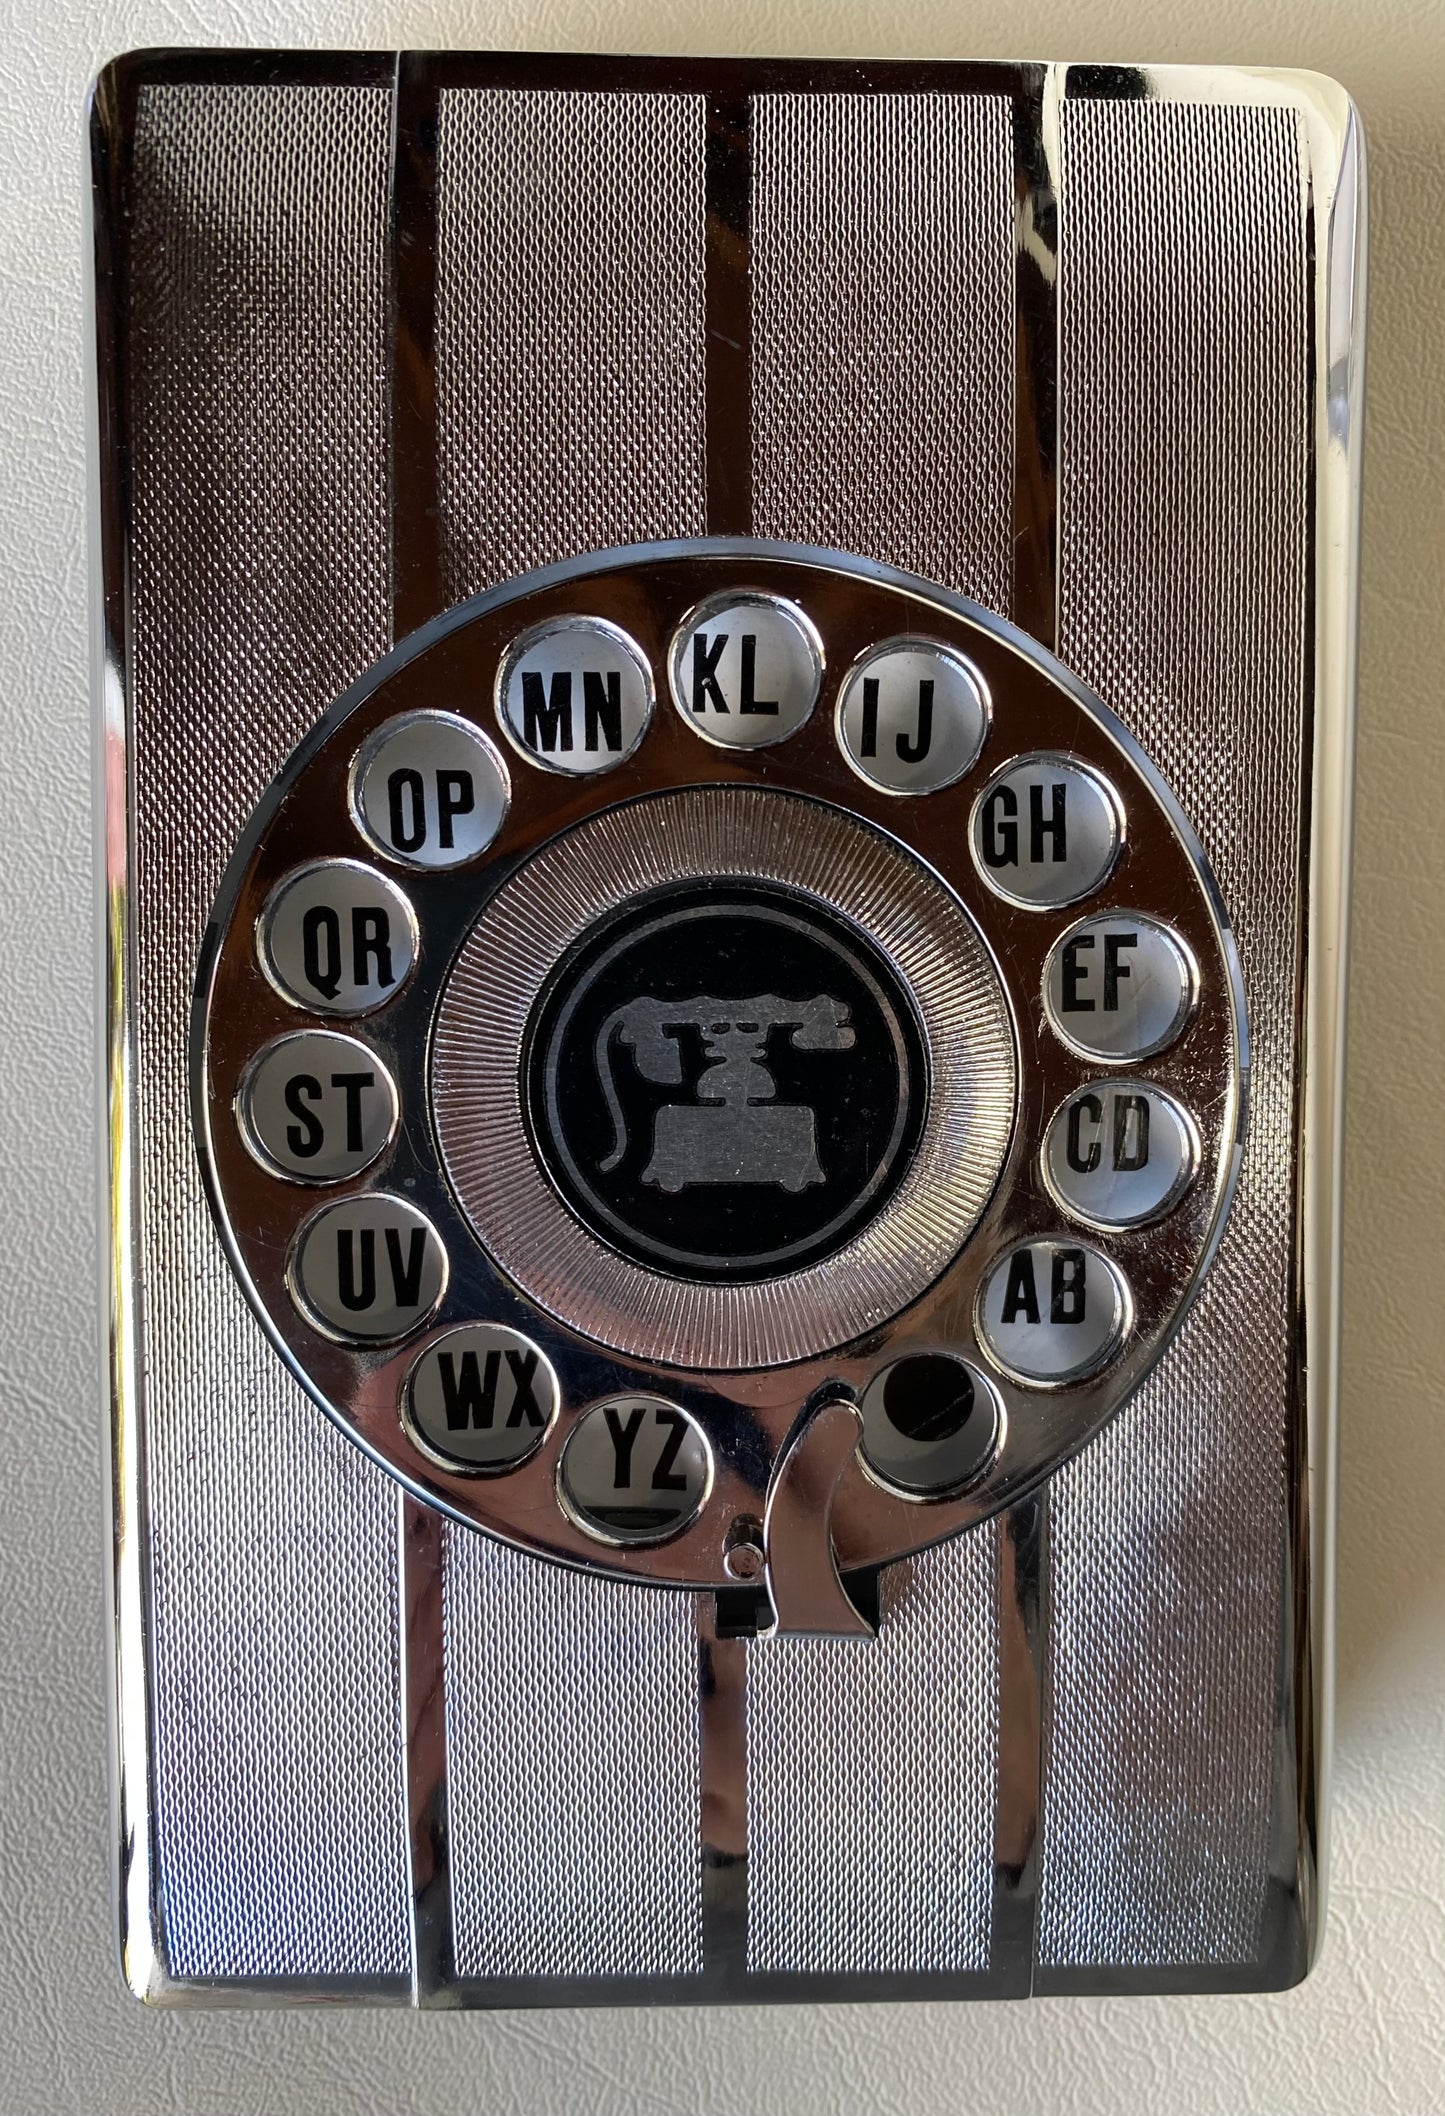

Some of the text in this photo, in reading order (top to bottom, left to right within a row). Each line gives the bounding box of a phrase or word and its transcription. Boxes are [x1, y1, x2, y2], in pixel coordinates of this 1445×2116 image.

[521, 672, 623, 752] MN
[692, 633, 779, 714] KL
[861, 677, 934, 763] IJ
[388, 767, 475, 853] OP
[981, 783, 1067, 868] GH
[303, 905, 396, 1000] QR
[1061, 933, 1138, 1013] EF
[284, 1072, 375, 1158] ST
[1066, 1094, 1150, 1173] CD
[337, 1227, 427, 1311] UV
[1000, 1248, 1086, 1324] AB
[438, 1348, 544, 1429] WX
[603, 1407, 687, 1491] YZ
